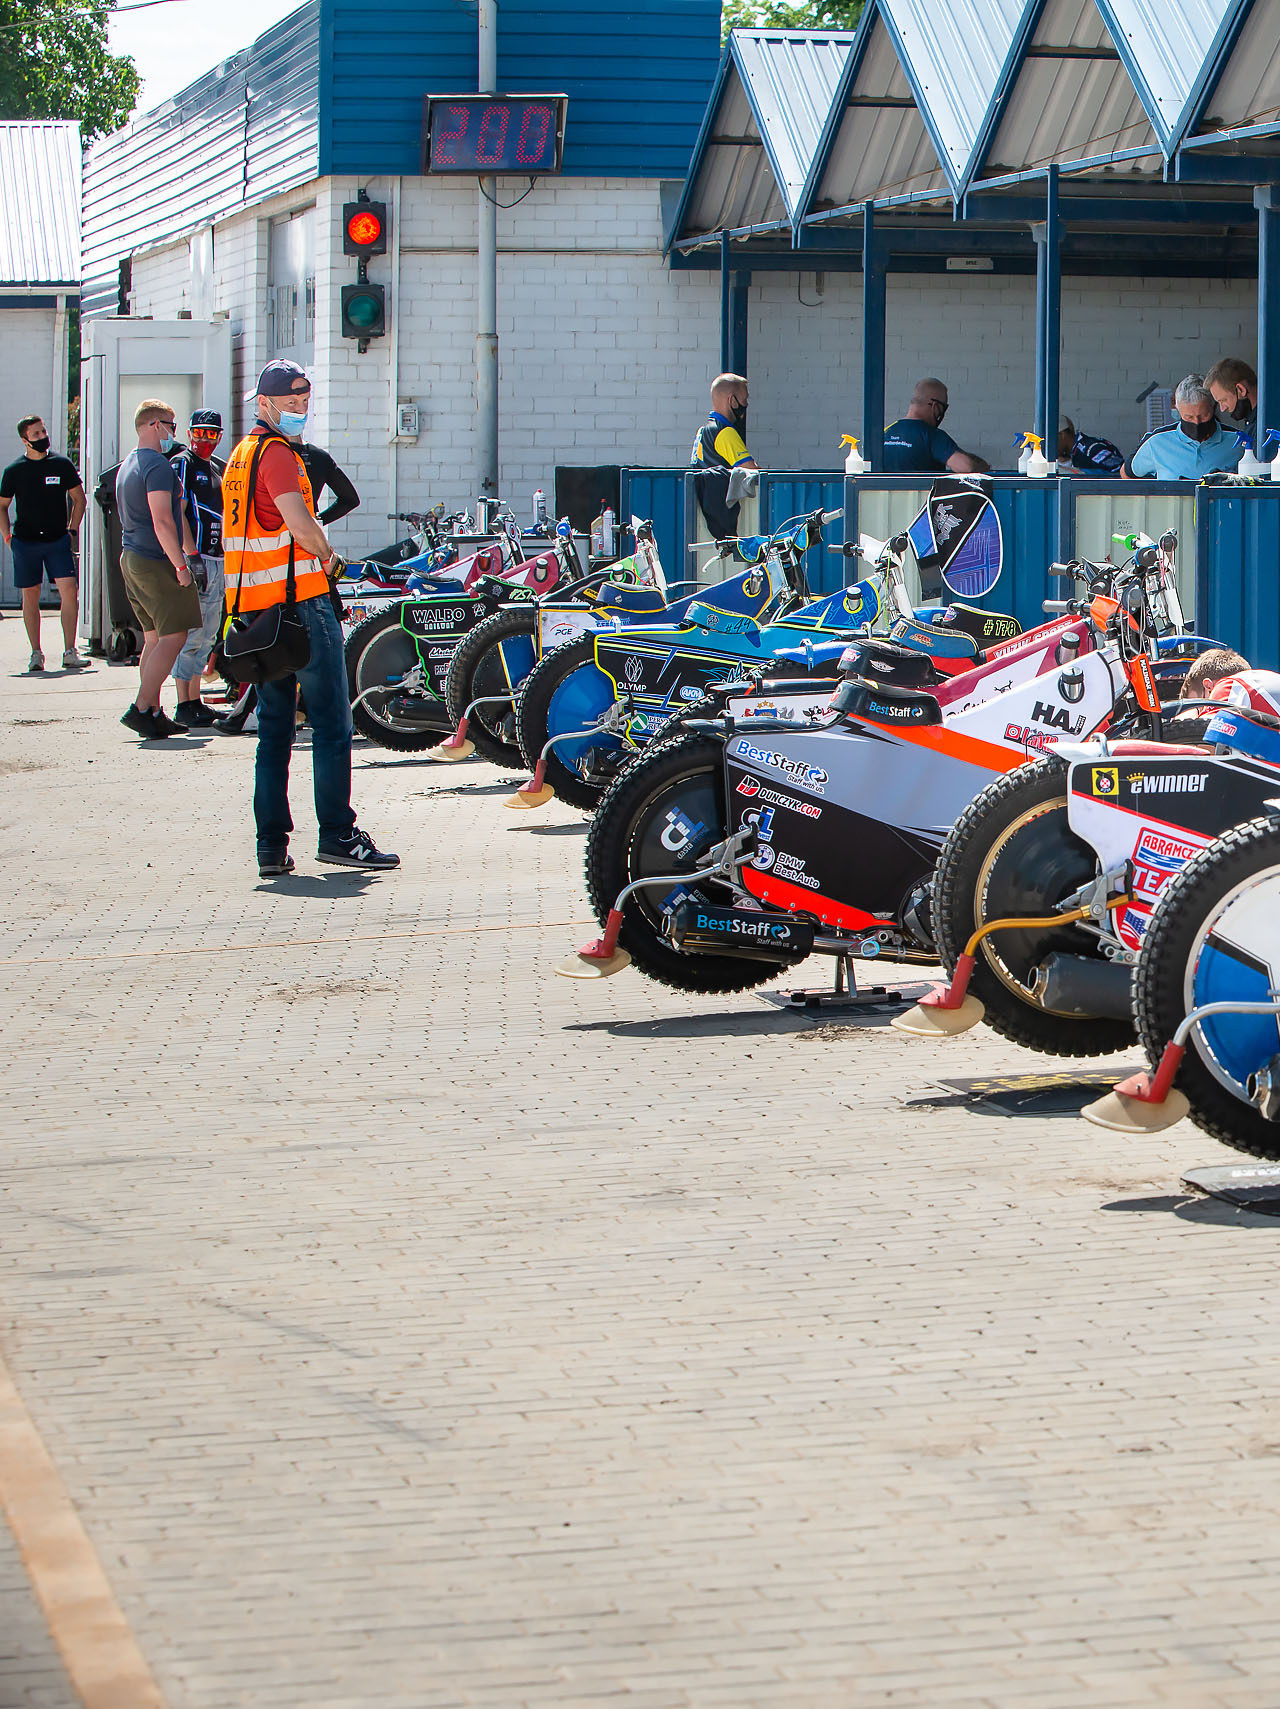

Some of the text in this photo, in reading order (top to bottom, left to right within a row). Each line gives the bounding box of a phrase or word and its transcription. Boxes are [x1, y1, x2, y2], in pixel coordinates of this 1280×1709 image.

[434, 106, 551, 164] 200
[231, 498, 240, 527] 3
[412, 607, 465, 624] WALBO
[555, 628, 573, 636] PGE
[617, 681, 648, 692] OLYMP
[869, 701, 912, 718] BestStaff
[736, 740, 810, 777] BestStaff
[787, 774, 802, 786] Staff
[802, 780, 816, 790] with
[758, 788, 823, 820] DUNCZYK.COM
[1142, 834, 1197, 861] ABRAMCZ
[777, 852, 806, 870] BMW
[696, 914, 771, 937] BestStaff
